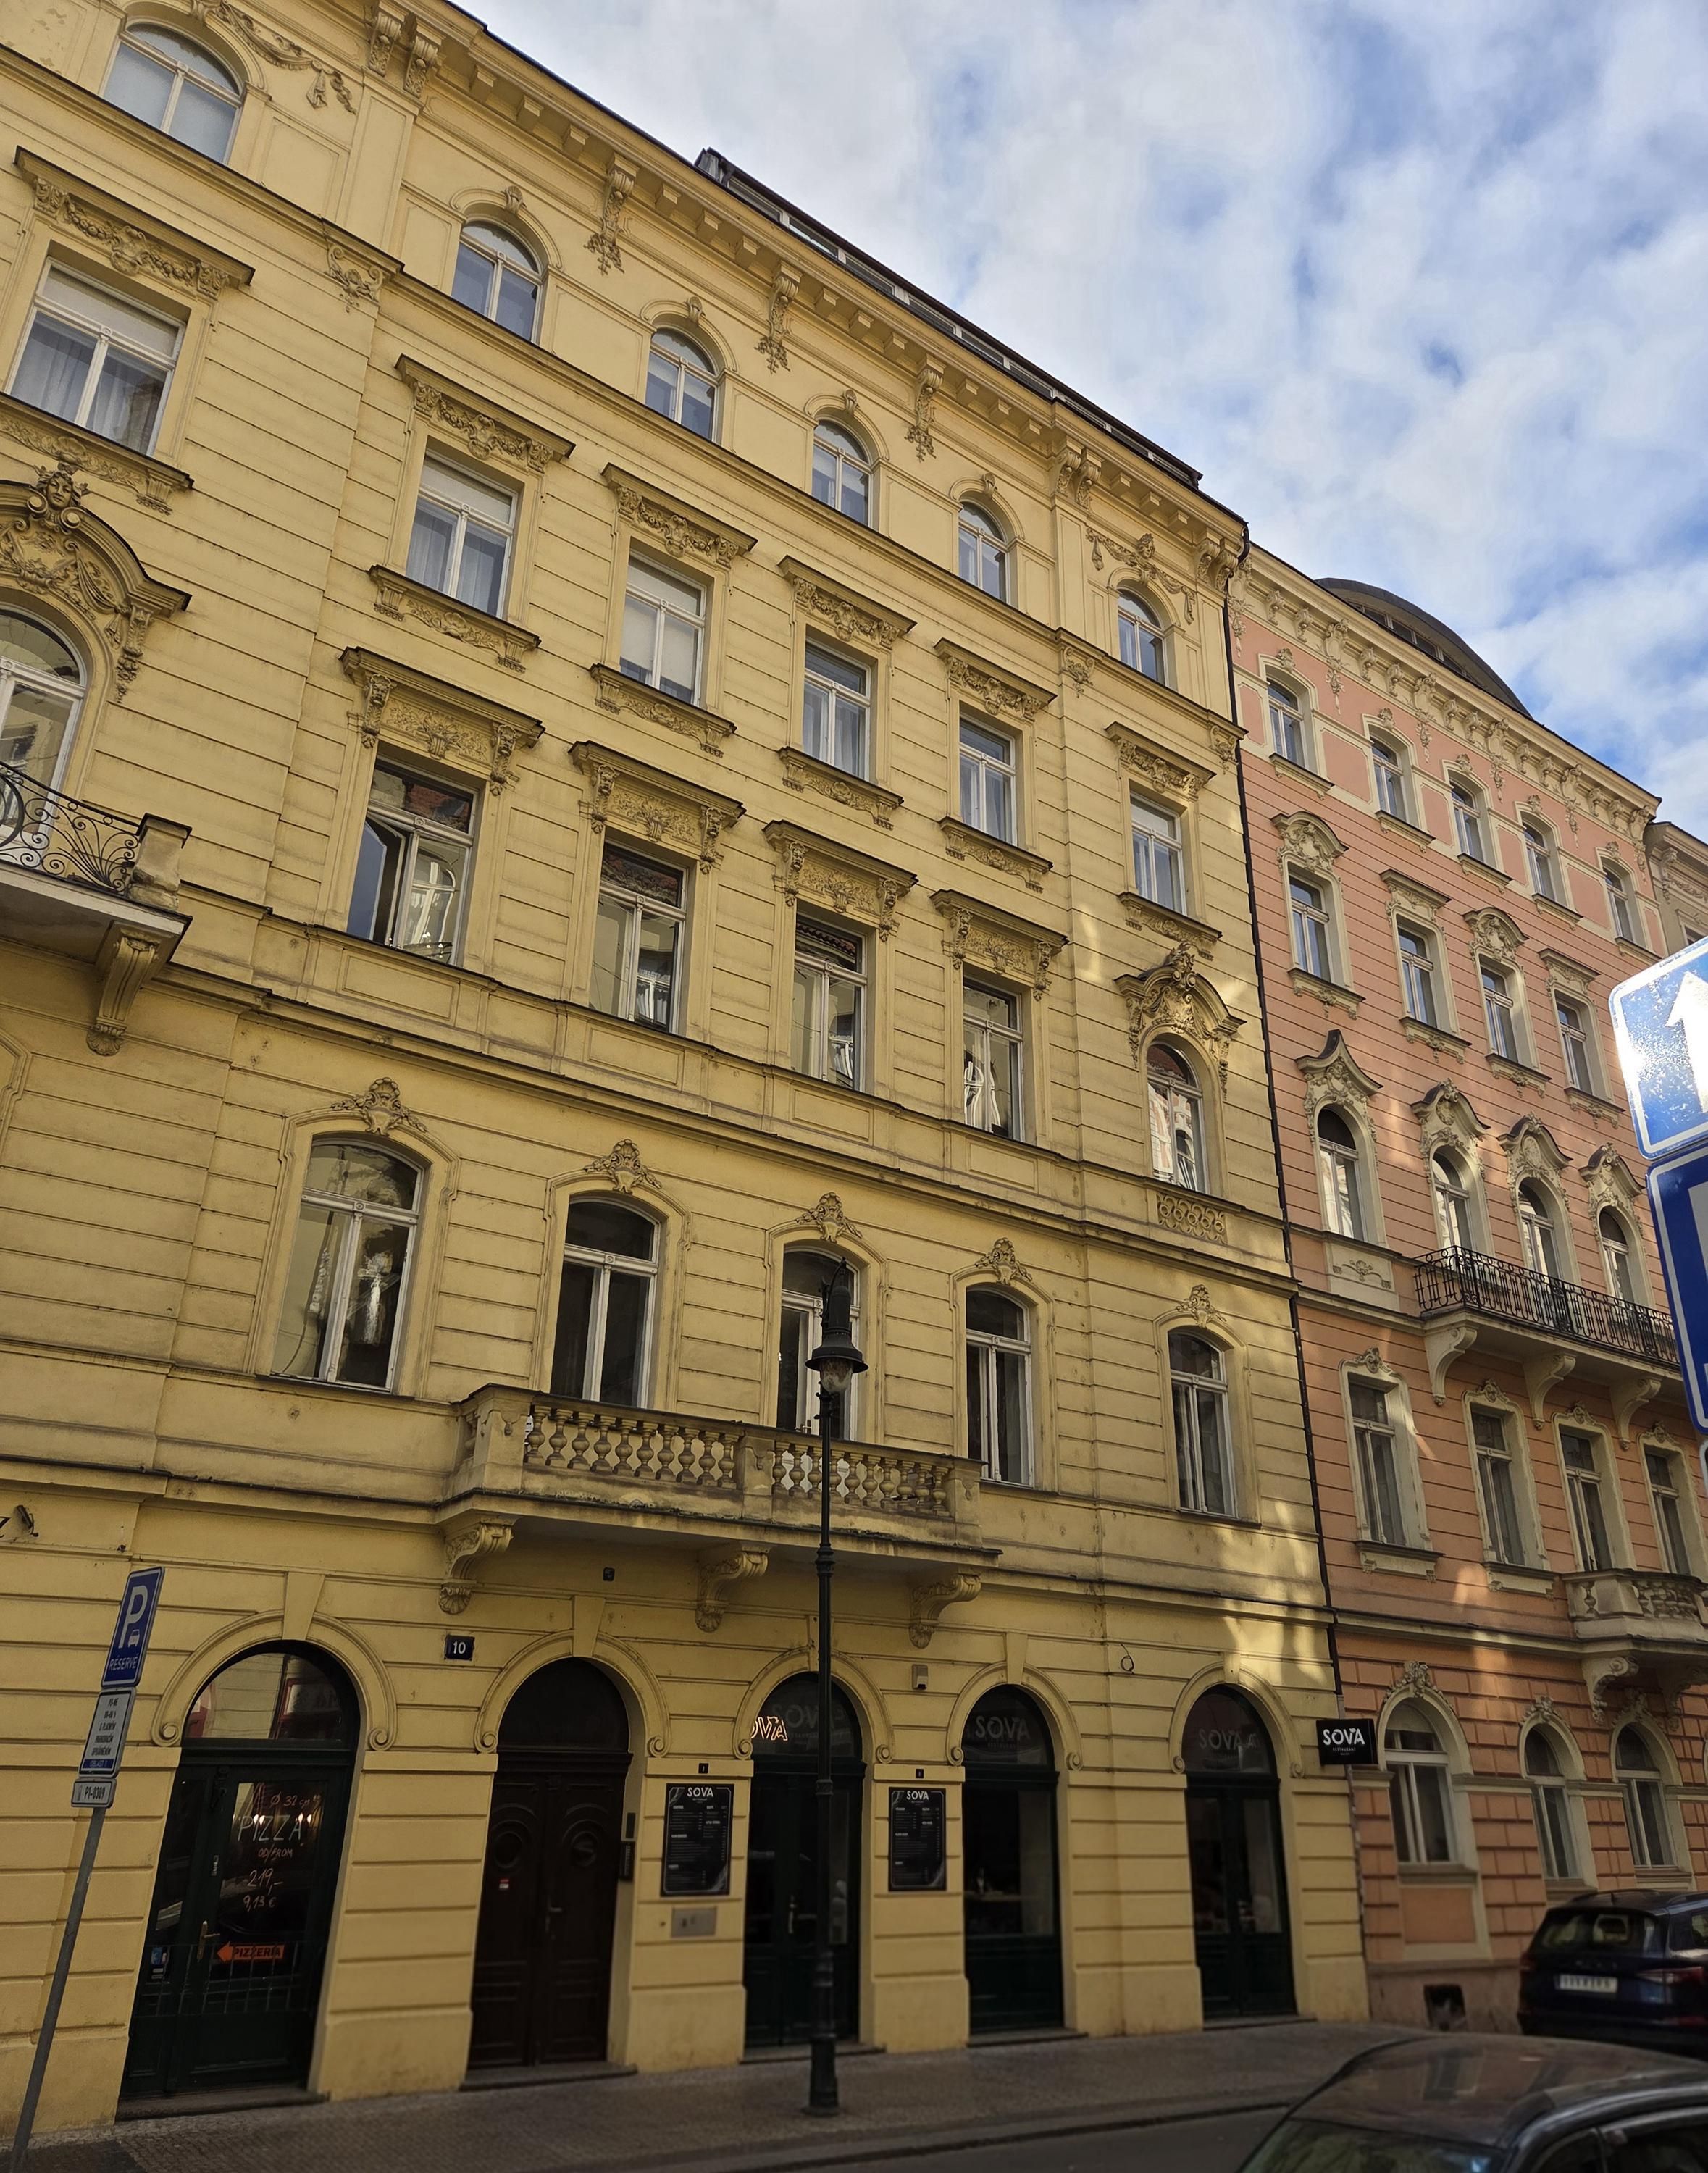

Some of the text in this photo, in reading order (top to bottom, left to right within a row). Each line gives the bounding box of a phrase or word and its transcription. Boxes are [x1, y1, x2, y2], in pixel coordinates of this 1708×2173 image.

[118, 1585, 148, 1649] P
[453, 1641, 466, 1654] 10
[975, 1715, 1031, 1741] SOVA
[1323, 1728, 1365, 1746] SOVA
[687, 1787, 714, 1797] SOVA
[906, 1791, 929, 1801] SOVA
[283, 1795, 298, 1806] 32
[238, 1815, 301, 1841] PIZZA
[234, 1946, 281, 1958] PIZZERIA
